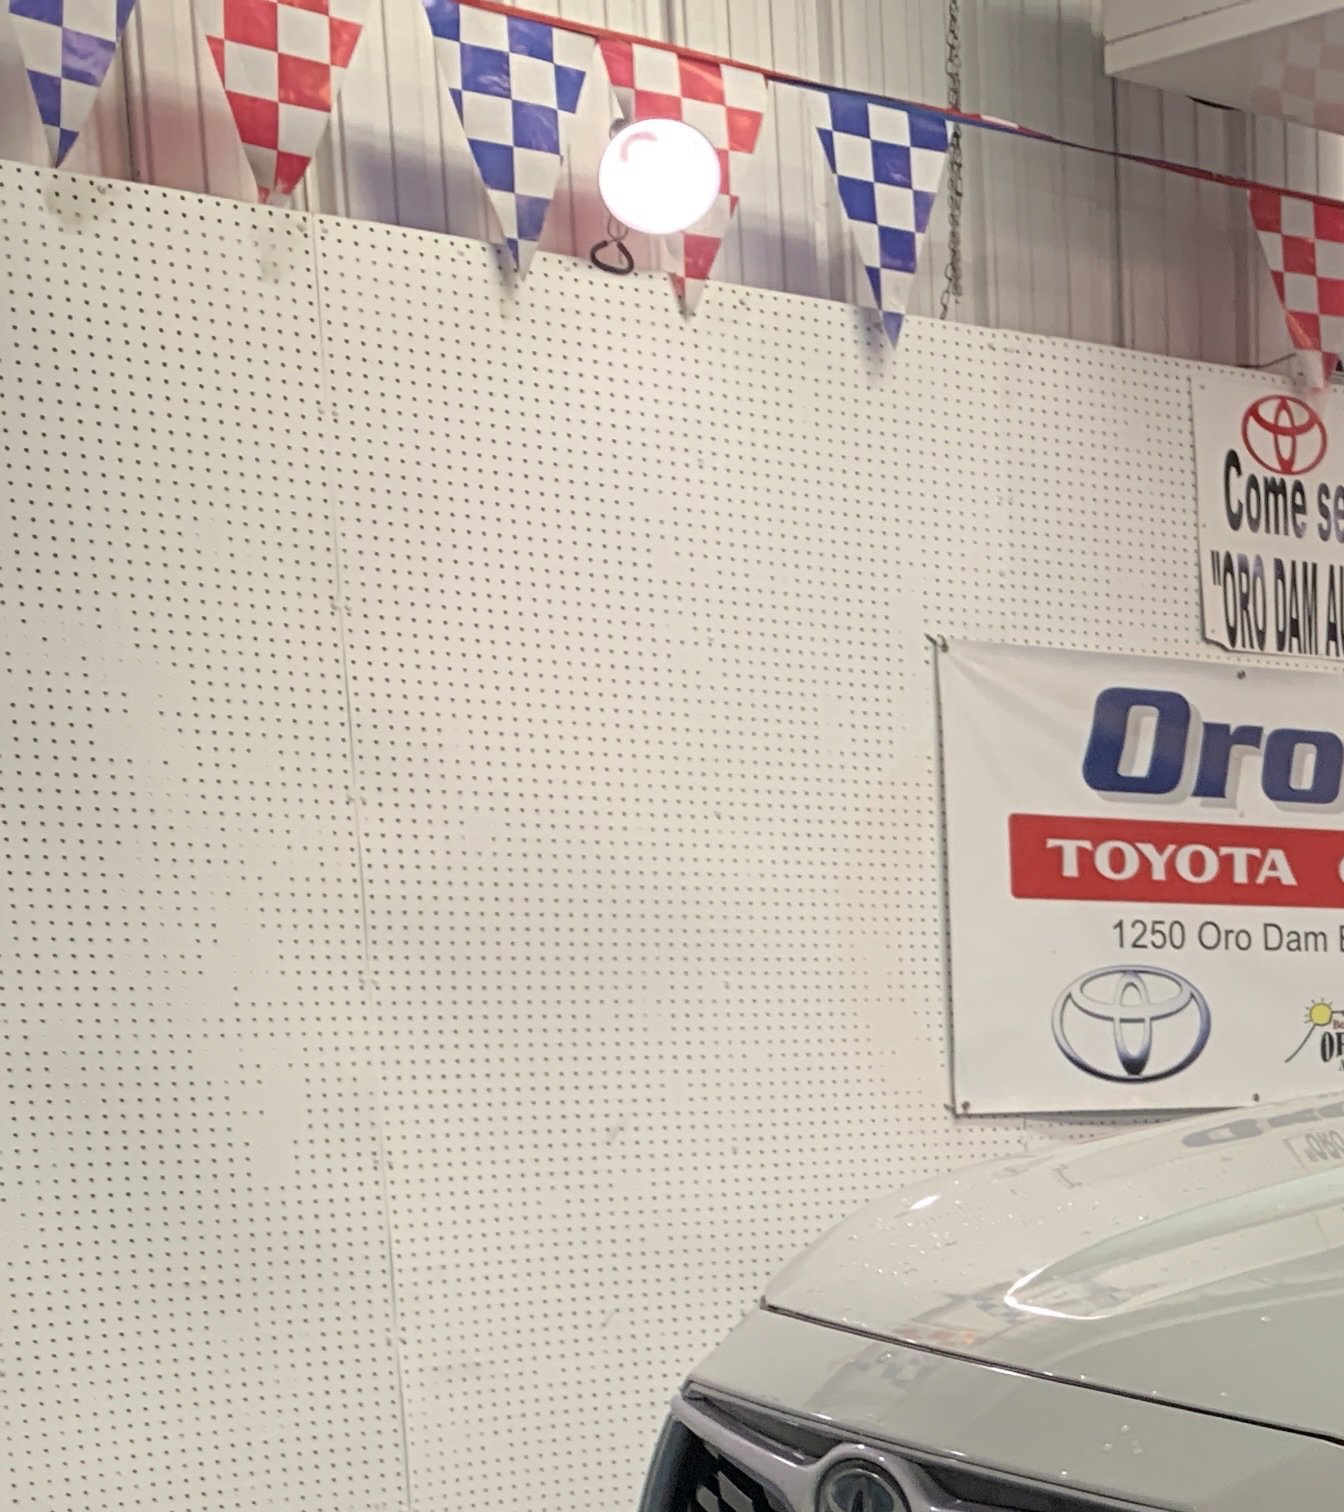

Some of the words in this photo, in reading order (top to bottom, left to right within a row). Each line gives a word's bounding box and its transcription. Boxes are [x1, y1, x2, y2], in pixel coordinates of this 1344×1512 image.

[1224, 448, 1307, 539] Come
[1211, 550, 1266, 652] "ORO
[1273, 557, 1319, 655] DAM
[1046, 838, 1298, 887] TOYOTA
[1113, 919, 1185, 951] 1250
[1198, 921, 1252, 952] Oro
[1264, 923, 1327, 953] Dam
